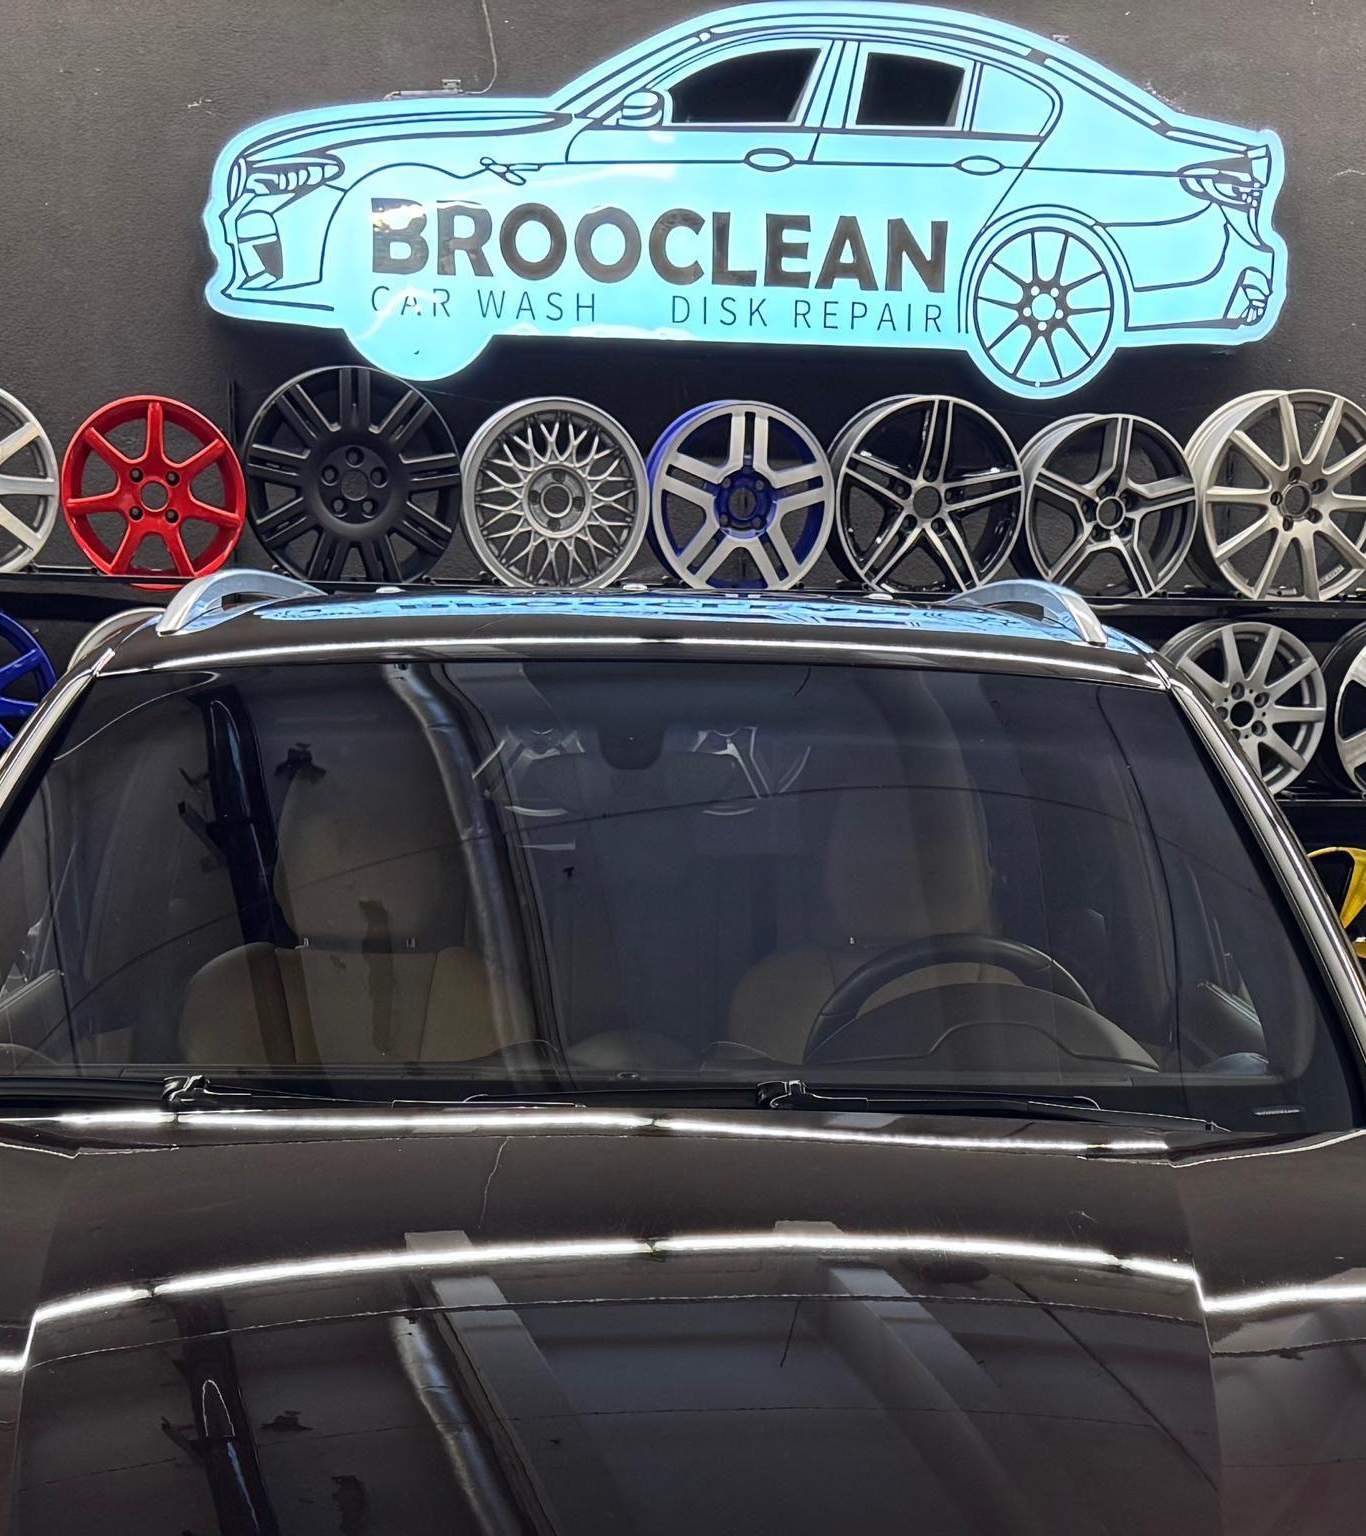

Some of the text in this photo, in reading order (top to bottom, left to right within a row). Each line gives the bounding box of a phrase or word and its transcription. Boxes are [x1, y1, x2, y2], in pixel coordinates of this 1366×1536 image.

[370, 197, 949, 294] BROOCLEAN
[371, 286, 943, 334] CAR WASH DISK REPAIR
